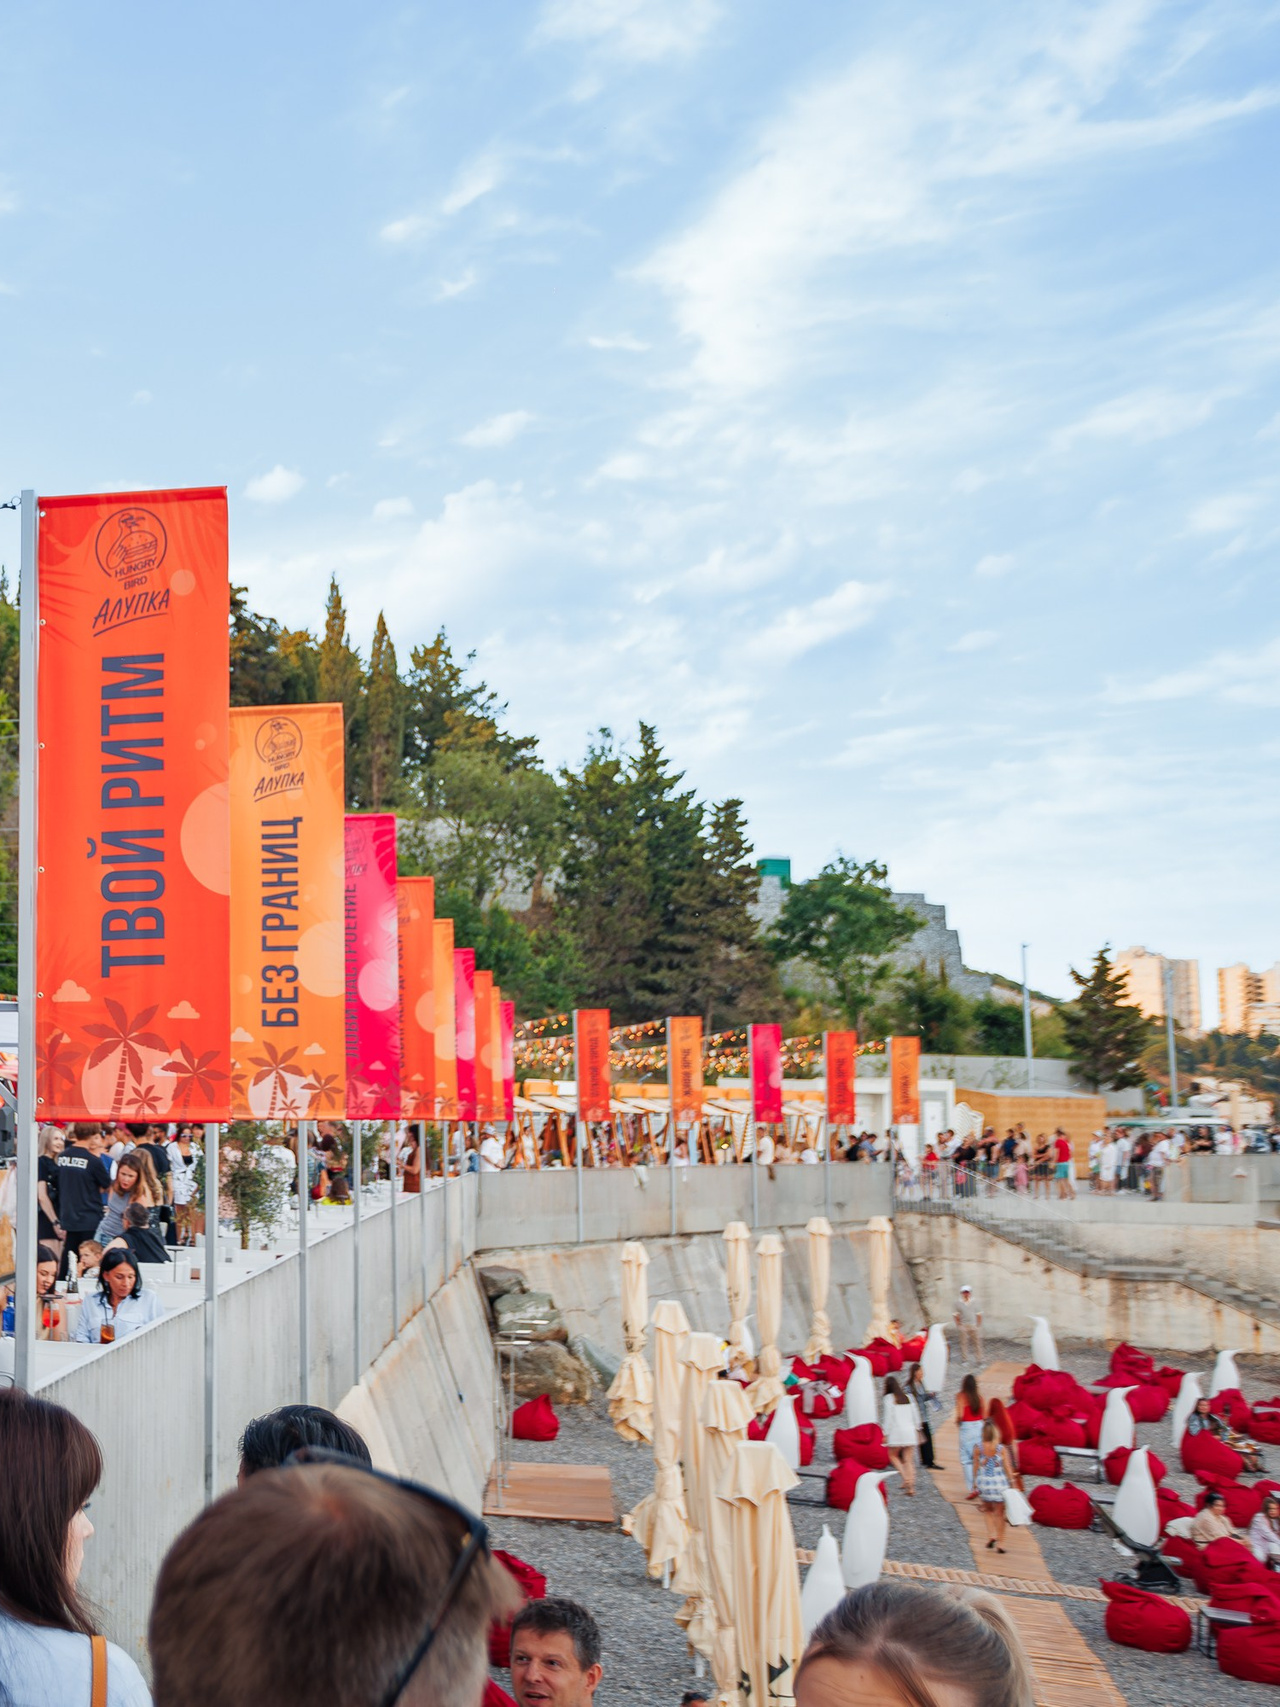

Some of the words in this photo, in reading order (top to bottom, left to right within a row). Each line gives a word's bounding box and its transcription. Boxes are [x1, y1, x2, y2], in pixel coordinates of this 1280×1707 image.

[114, 557, 157, 578] HUNGRY
[124, 575, 148, 590] BIRD
[92, 588, 170, 629] АЛУПКА
[101, 653, 166, 808] РИТМ
[253, 771, 305, 797] АЛУПКА
[87, 828, 166, 978] ТВОЙ
[261, 816, 303, 953] ГРАНИЦ
[261, 960, 299, 1028] БЕЗ
